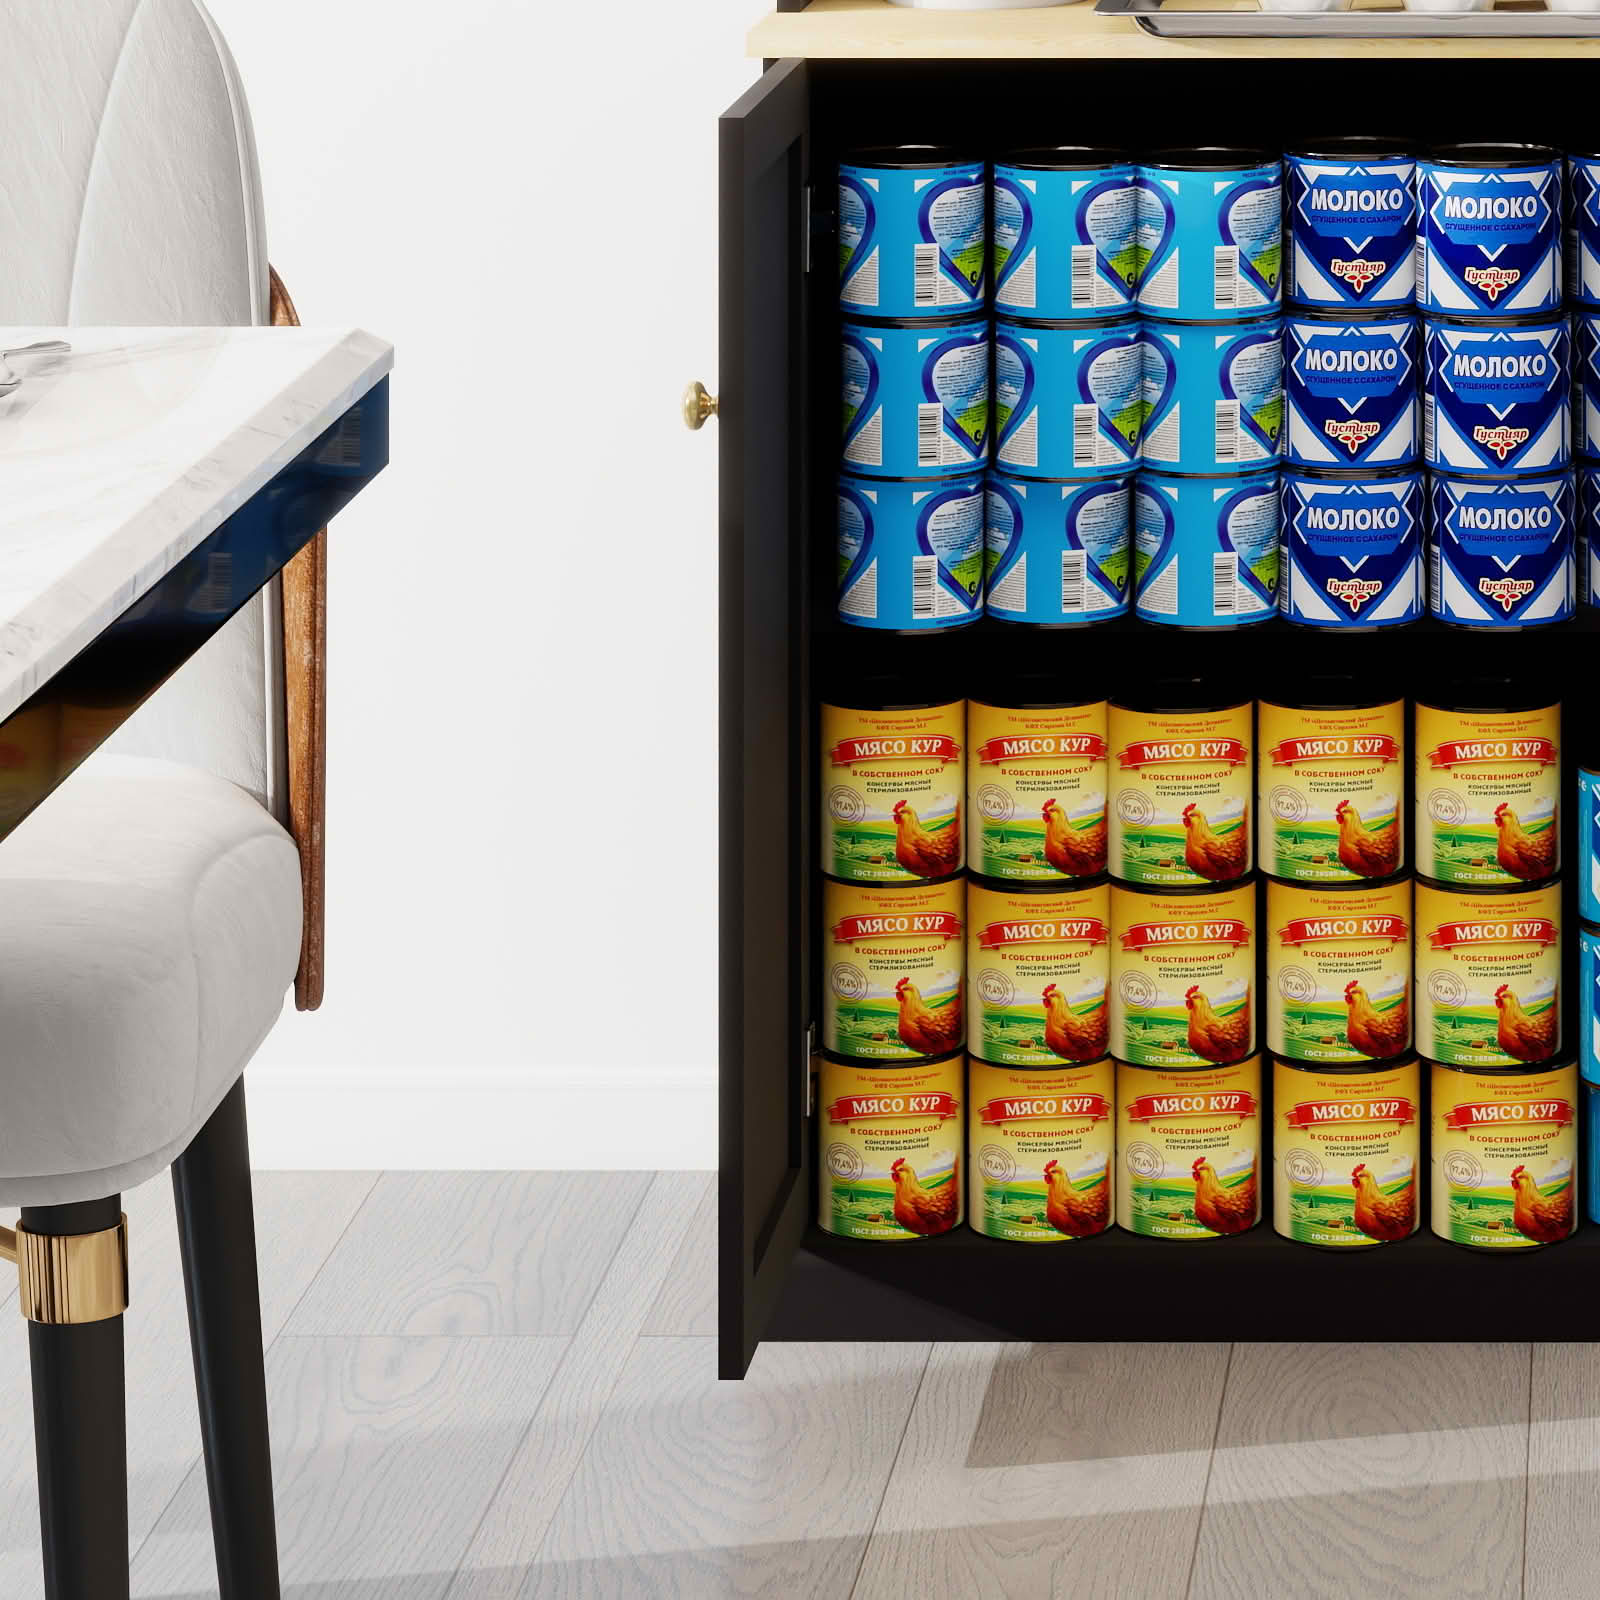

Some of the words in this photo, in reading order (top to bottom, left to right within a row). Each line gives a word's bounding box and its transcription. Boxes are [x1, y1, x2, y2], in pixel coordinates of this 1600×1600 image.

[1310, 188, 1404, 212] МОЛОКО
[1444, 195, 1538, 219] МОЛОКО
[1332, 259, 1385, 276] Густияр
[1466, 267, 1519, 284] Густияр
[1304, 348, 1398, 372] МОЛОКО
[1453, 354, 1547, 378] МОЛОКО
[1326, 420, 1379, 437] Густияр
[1475, 426, 1528, 443] Густияр
[1306, 507, 1400, 531] МОЛОКО
[1458, 506, 1552, 530] МОЛОКО
[1328, 578, 1381, 595] Густияр
[1480, 578, 1533, 595] Густияр
[853, 739, 907, 756] МЯСО
[910, 738, 942, 754] КУР
[1002, 738, 1056, 755] МЯСО
[1059, 737, 1091, 753] КУР
[1142, 743, 1196, 760] МЯСО
[1199, 742, 1231, 758] КУР
[1295, 739, 1349, 756] МЯСО
[1352, 738, 1384, 754] КУР
[1454, 742, 1508, 759] МЯСО
[1511, 741, 1542, 757] КУР
[859, 769, 923, 778] СОБСТВЕННОМ
[924, 767, 944, 775] СОКУ
[856, 917, 908, 934] МЯСО
[912, 915, 945, 931] КУР
[1002, 923, 1056, 940] МЯСО
[1059, 921, 1092, 937] КУР
[1145, 925, 1199, 942] МЯСО
[1202, 923, 1234, 939] КУР
[1304, 920, 1358, 937] МЯСО
[1362, 918, 1392, 934] КУР
[1454, 924, 1510, 941] МЯСО
[1512, 922, 1543, 938] КУР
[1310, 950, 1374, 959] СОБСТВЕННОМ
[1375, 947, 1394, 955] СОКУ
[851, 1097, 905, 1114] МЯСО
[908, 1096, 940, 1112] КУР
[1004, 1099, 1058, 1116] МЯСО
[1061, 1097, 1093, 1113] КУР
[1152, 1096, 1206, 1113] МЯСО
[1209, 1095, 1240, 1111] КУР
[1311, 1103, 1365, 1120] МЯСО
[1369, 1101, 1400, 1117] КУР
[1470, 1104, 1526, 1121] МЯСО
[1528, 1103, 1559, 1119] КУР
